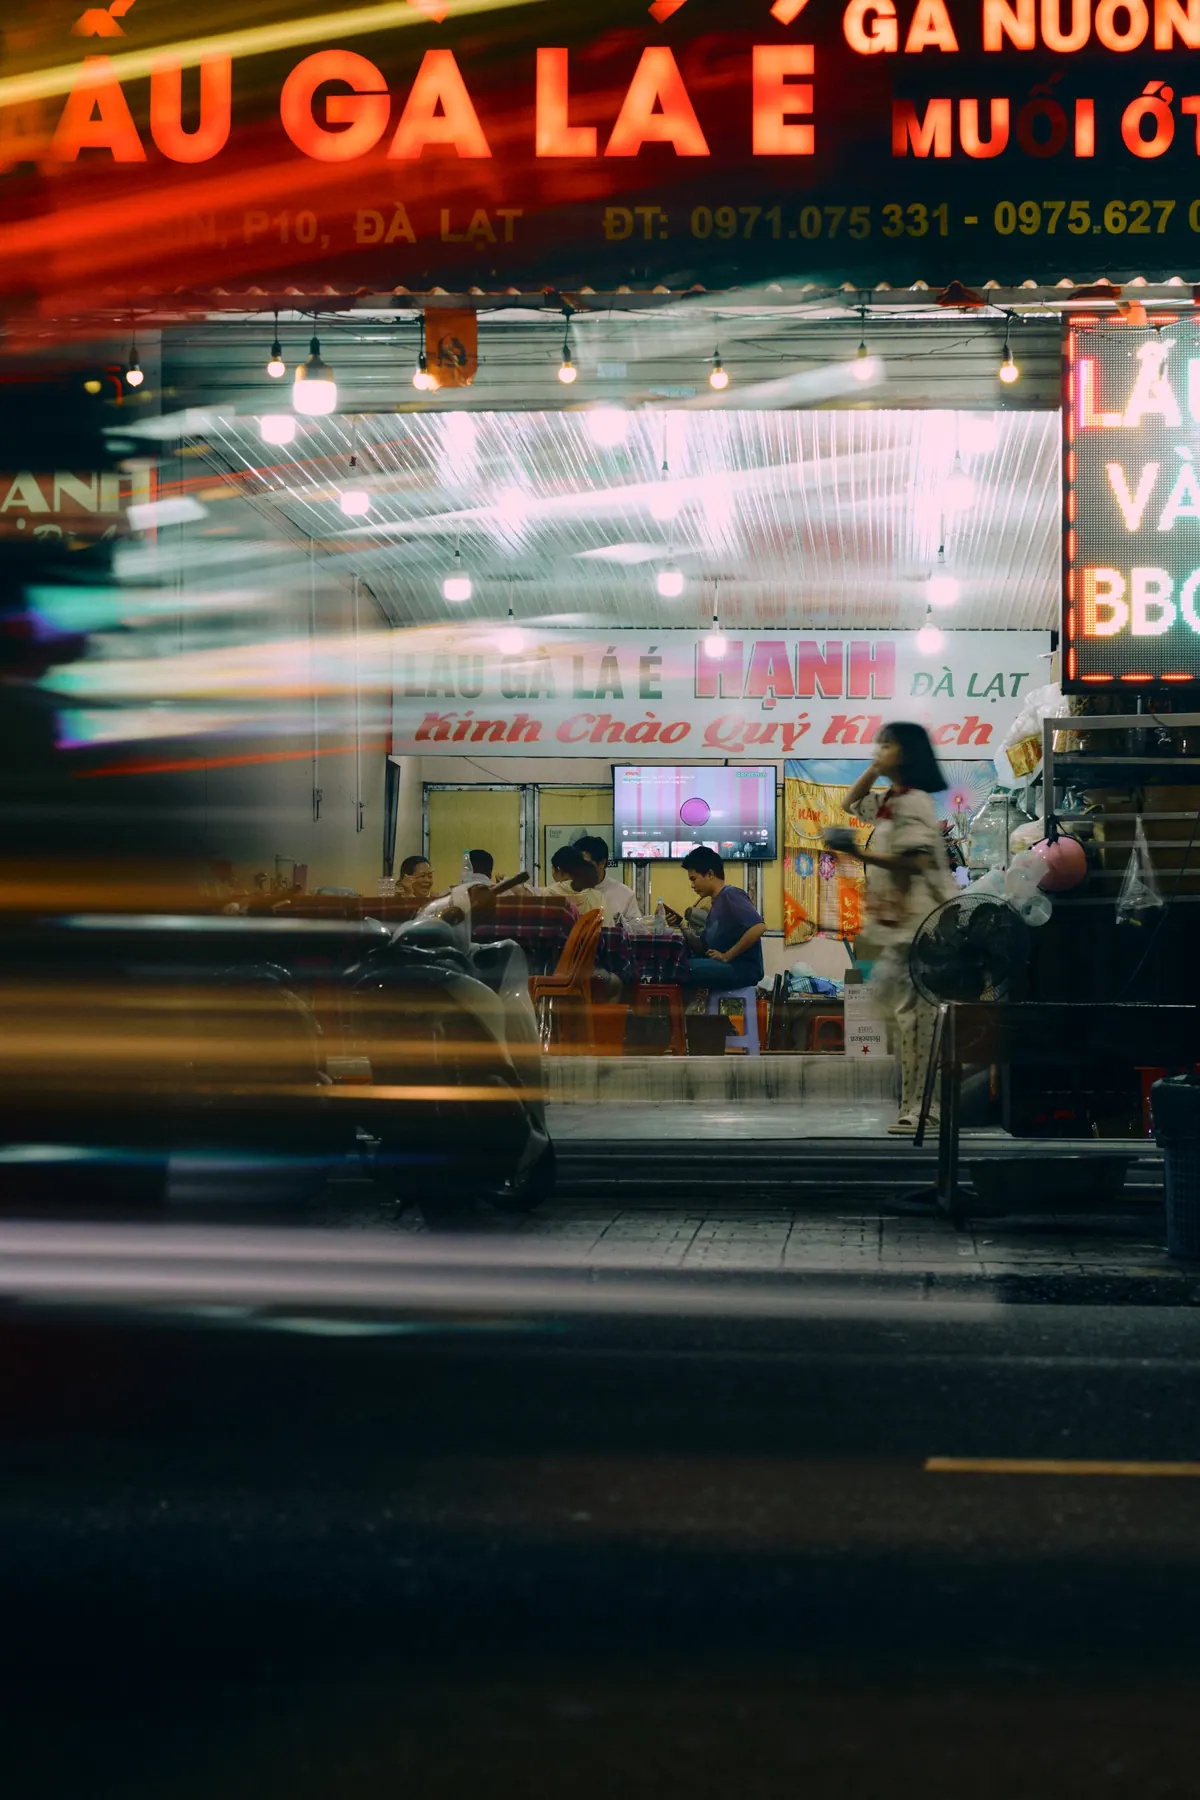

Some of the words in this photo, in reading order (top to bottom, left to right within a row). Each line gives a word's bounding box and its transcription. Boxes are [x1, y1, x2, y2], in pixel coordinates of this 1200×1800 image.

[280, 0, 491, 163] GÀ
[536, 0, 710, 157] LÁ
[353, 201, 416, 244] ĐÀ
[440, 208, 523, 250] LẠT
[603, 206, 669, 240] ĐT:
[1105, 447, 1200, 531] VÀ
[572, 646, 624, 699] LÁ
[639, 646, 663, 699] É
[694, 640, 896, 710] HẠNH
[911, 666, 954, 698] ĐÀ
[966, 672, 1029, 703] LẠT
[414, 709, 543, 743] Kính
[556, 711, 692, 744] Chào
[702, 712, 811, 753] Quý
[822, 715, 993, 746] Khch
[850, 1035, 881, 1043] Heineken
